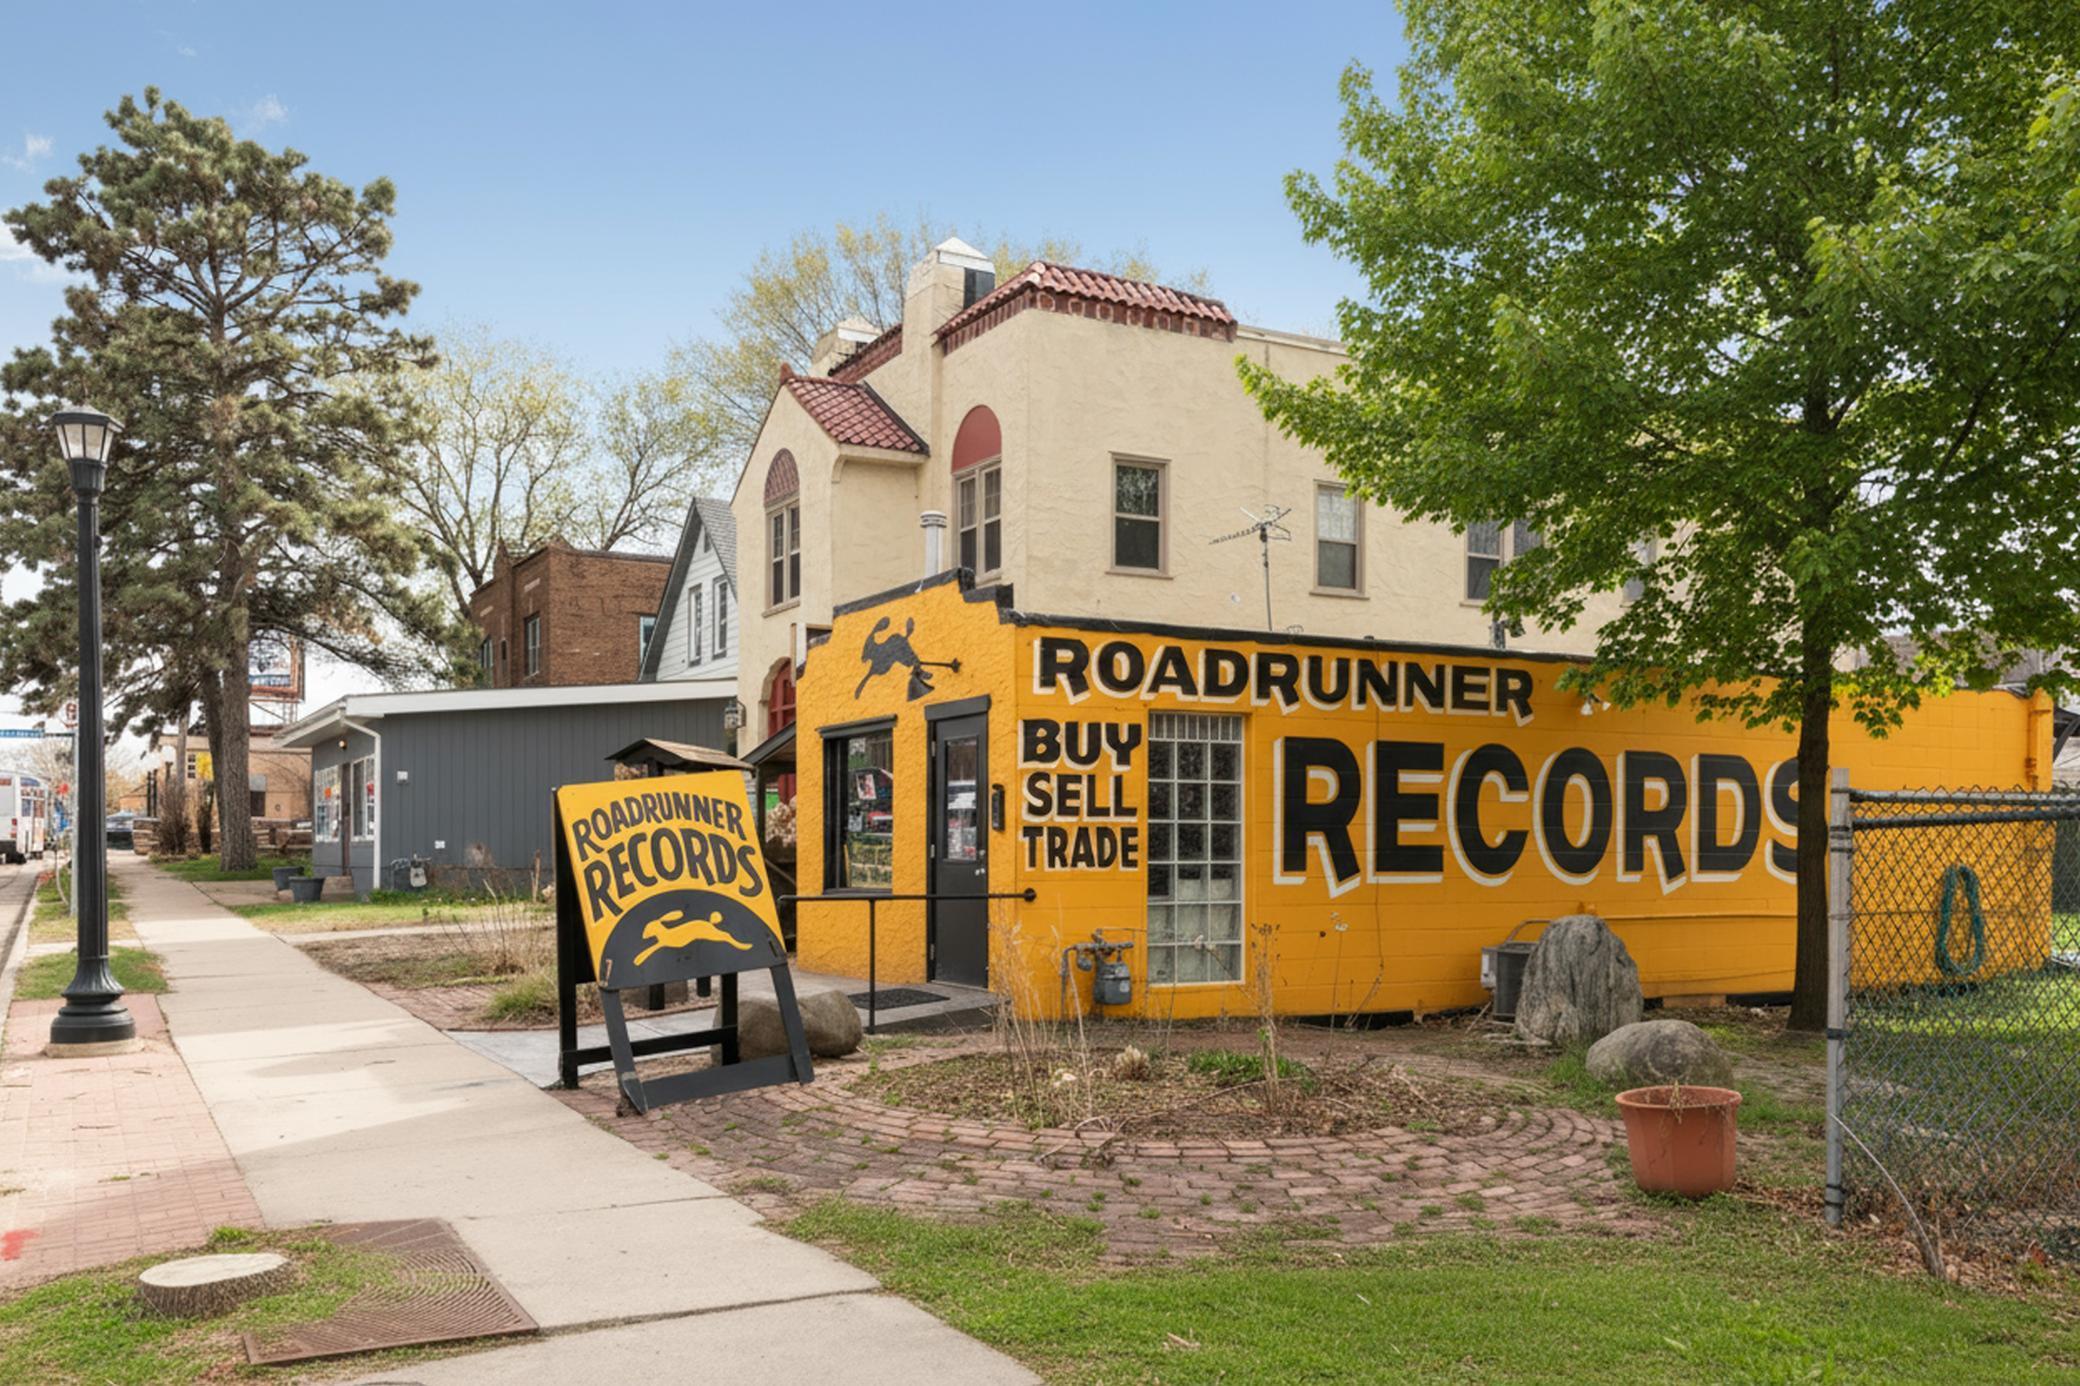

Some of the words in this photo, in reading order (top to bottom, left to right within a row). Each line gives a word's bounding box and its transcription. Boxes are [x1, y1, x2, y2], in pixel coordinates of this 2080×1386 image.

[1033, 636, 1534, 727] ROADRUNNER
[1018, 718, 1142, 772] BUY
[572, 791, 747, 862] ROADRUNNER
[1022, 772, 1138, 822] SELL
[584, 828, 763, 923] RECORDS
[1022, 826, 1140, 871] TRADE
